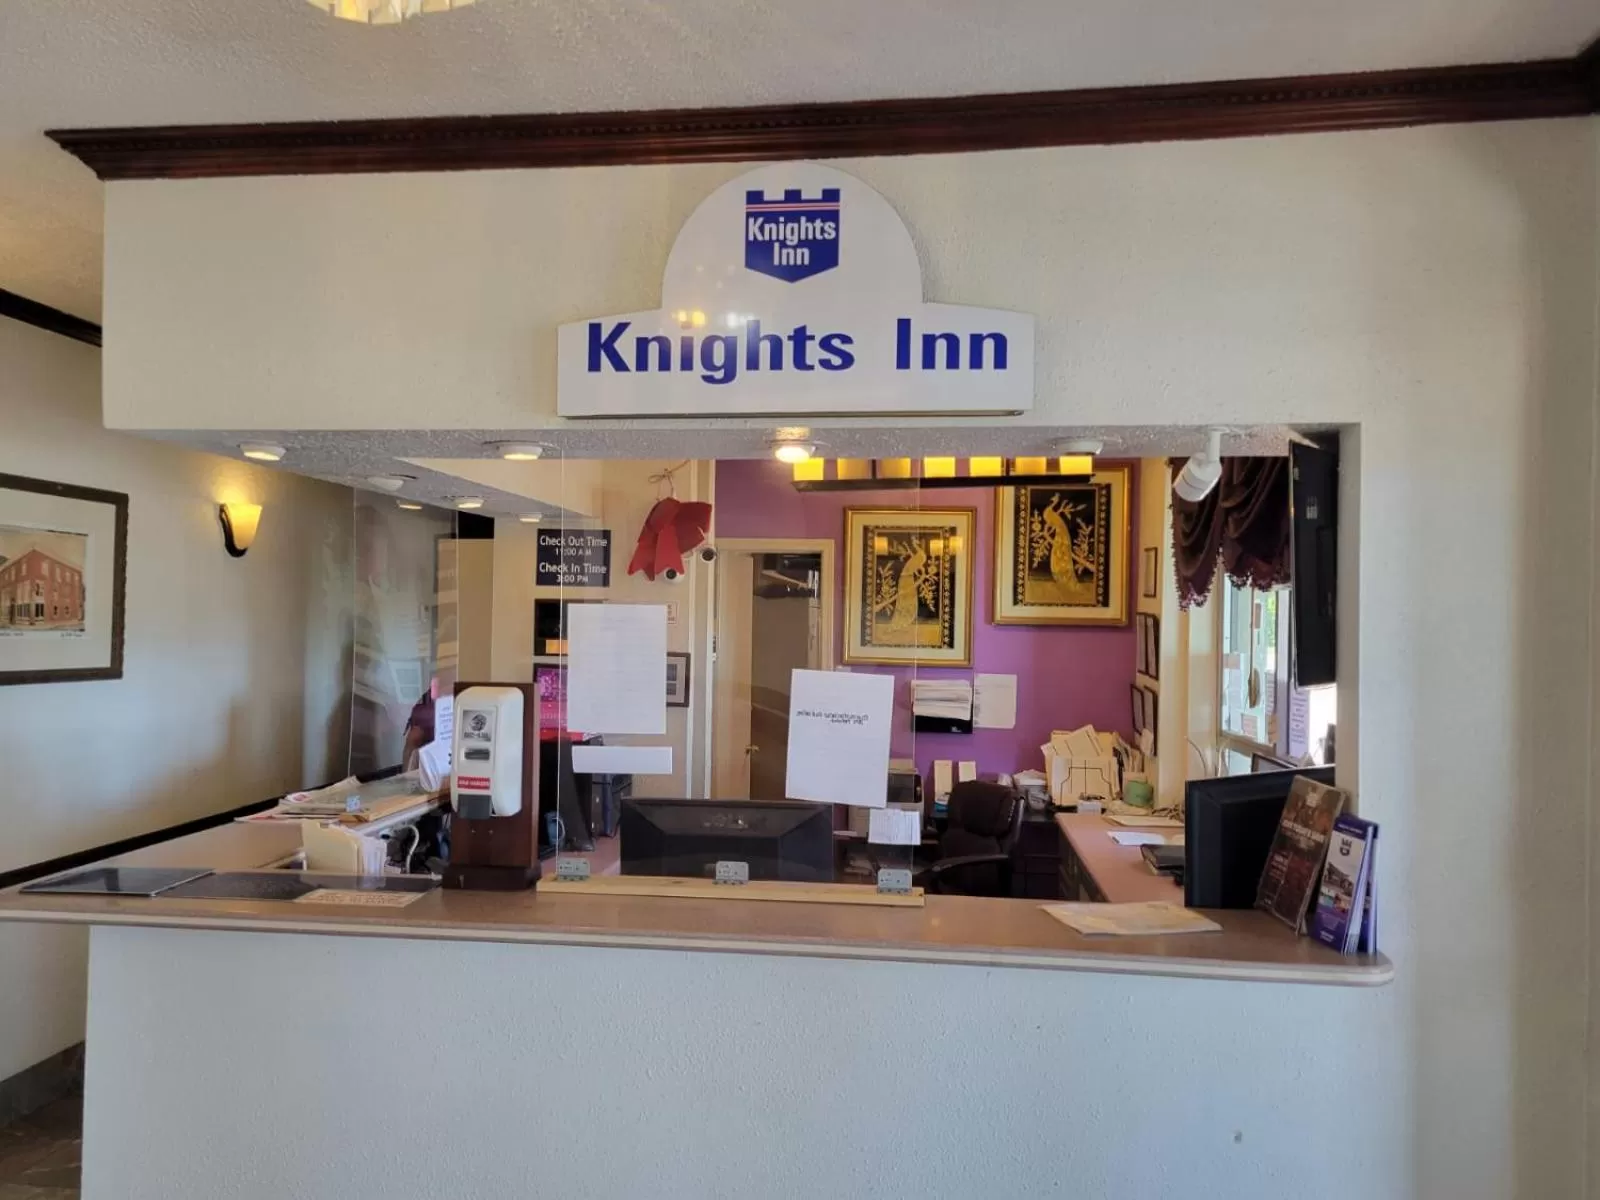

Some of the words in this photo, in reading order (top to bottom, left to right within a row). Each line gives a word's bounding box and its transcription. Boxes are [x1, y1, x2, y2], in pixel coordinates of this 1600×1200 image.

[747, 217, 837, 244] Knights
[773, 243, 810, 266] Inn
[587, 319, 855, 385] Knights
[896, 318, 1008, 370] Inn
[540, 535, 566, 546] Check
[568, 536, 584, 547] Out
[586, 536, 608, 547] Time
[539, 562, 568, 573] Check
[571, 563, 580, 573] In
[583, 563, 607, 574] Time
